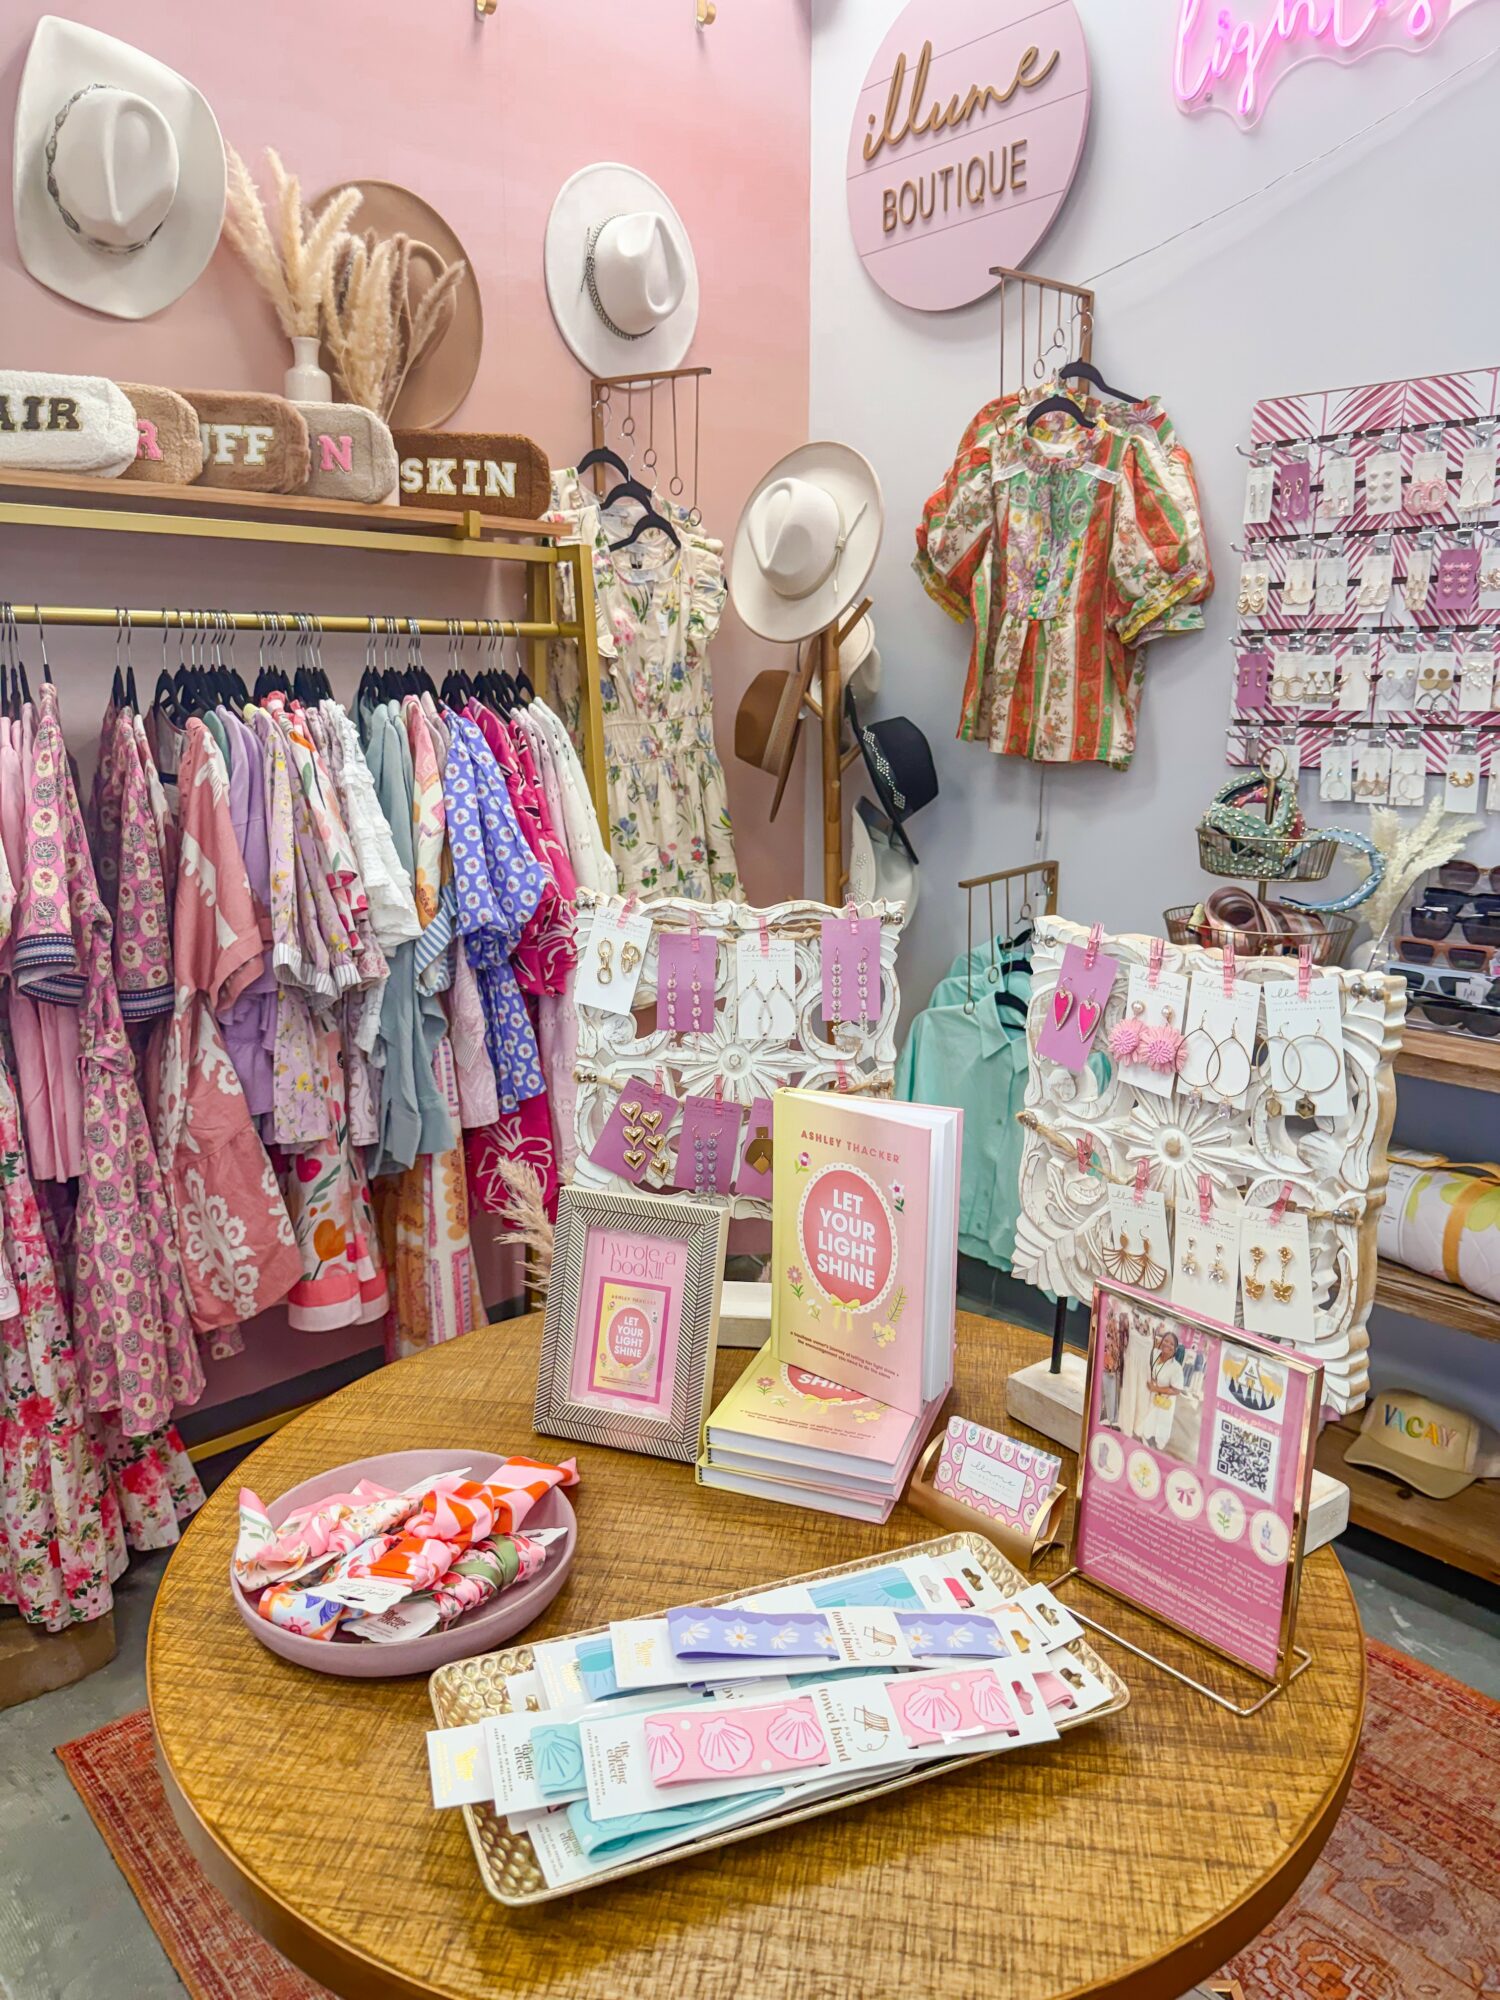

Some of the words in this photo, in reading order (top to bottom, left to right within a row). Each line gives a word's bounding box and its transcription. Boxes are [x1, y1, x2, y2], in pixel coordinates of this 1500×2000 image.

[863, 40, 1060, 161] illume
[883, 139, 1028, 233] BOUTIQUE
[400, 457, 517, 498] SKIN
[800, 1130, 842, 1148] ASHLEY
[847, 1142, 901, 1164] THACKER
[833, 1189, 863, 1215] LET
[820, 1207, 875, 1243] YOUR
[664, 1250, 677, 1267] a
[818, 1230, 876, 1266] LIGHT
[817, 1253, 875, 1290] SHINE
[617, 1325, 644, 1338] YOUR
[623, 1316, 639, 1327] LET
[614, 1345, 642, 1358] SHINE
[615, 1335, 644, 1347] LIGHT
[1383, 1403, 1459, 1449] VACAY
[841, 1637, 860, 1662] band
[818, 1688, 840, 1724] towel
[830, 1726, 852, 1763] band
[607, 1748, 618, 1783] effect.
[614, 1746, 627, 1785] darling
